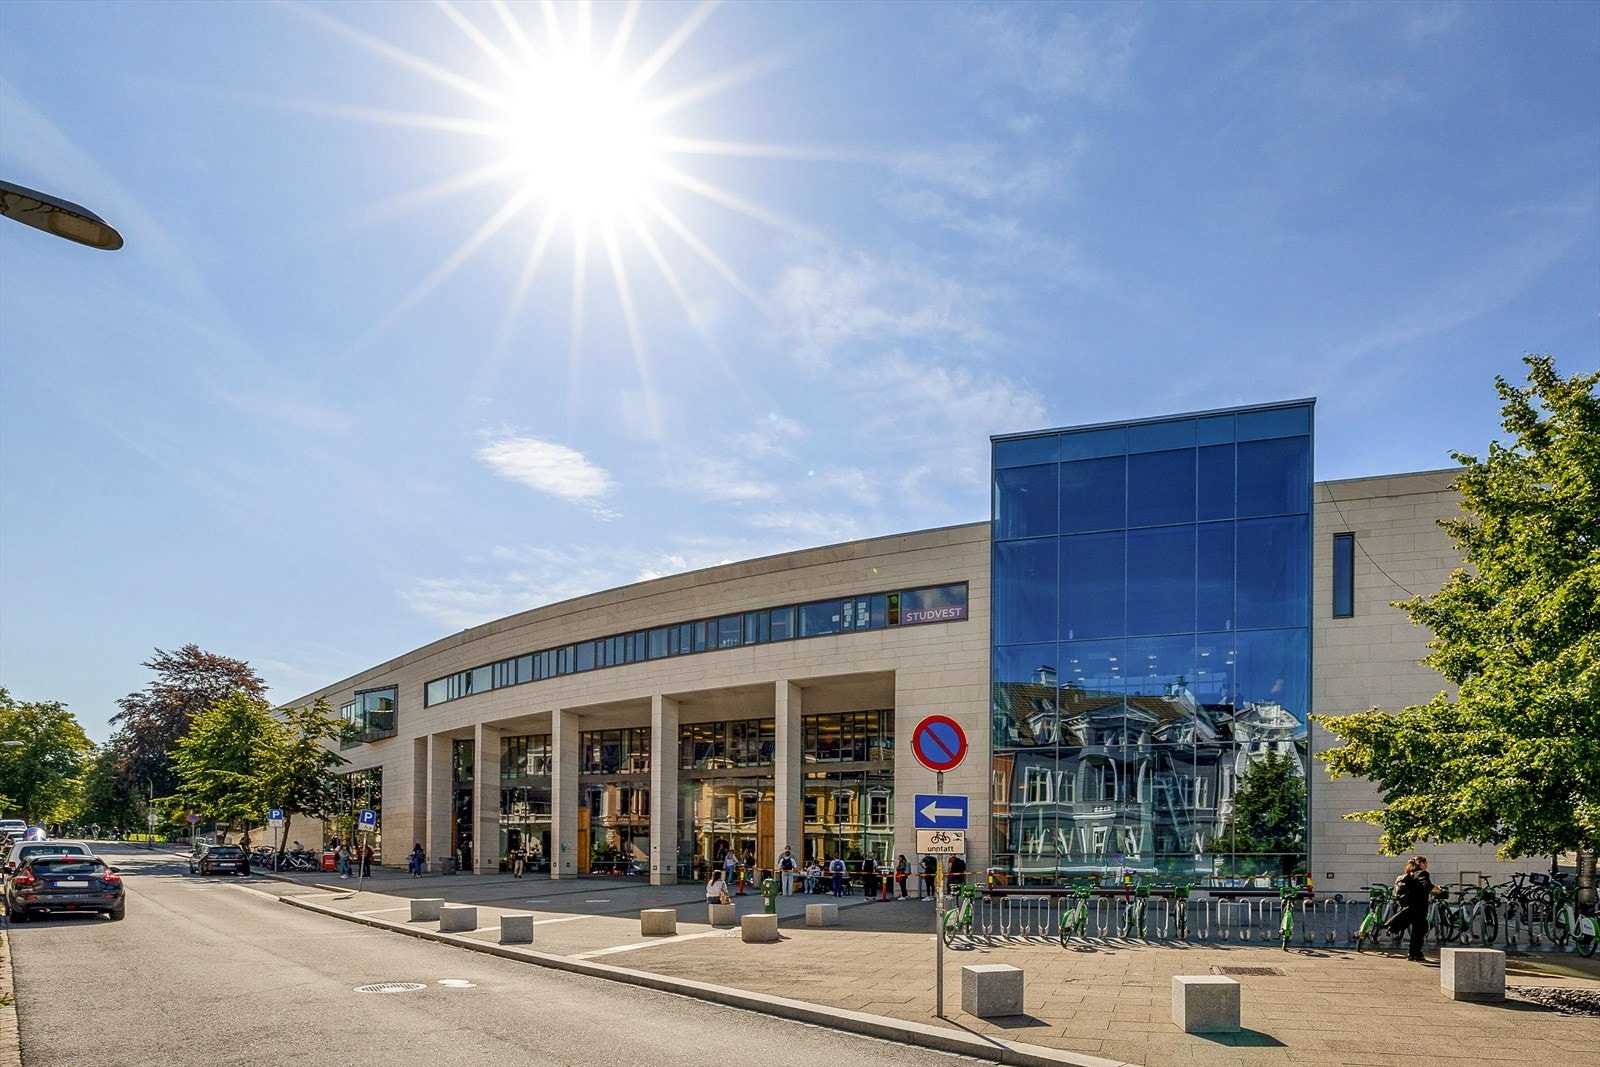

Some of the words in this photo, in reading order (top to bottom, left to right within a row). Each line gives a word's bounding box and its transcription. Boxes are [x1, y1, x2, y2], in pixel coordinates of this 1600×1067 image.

[906, 607, 962, 622] STUDVEST
[272, 810, 280, 819] P
[364, 811, 373, 822] P
